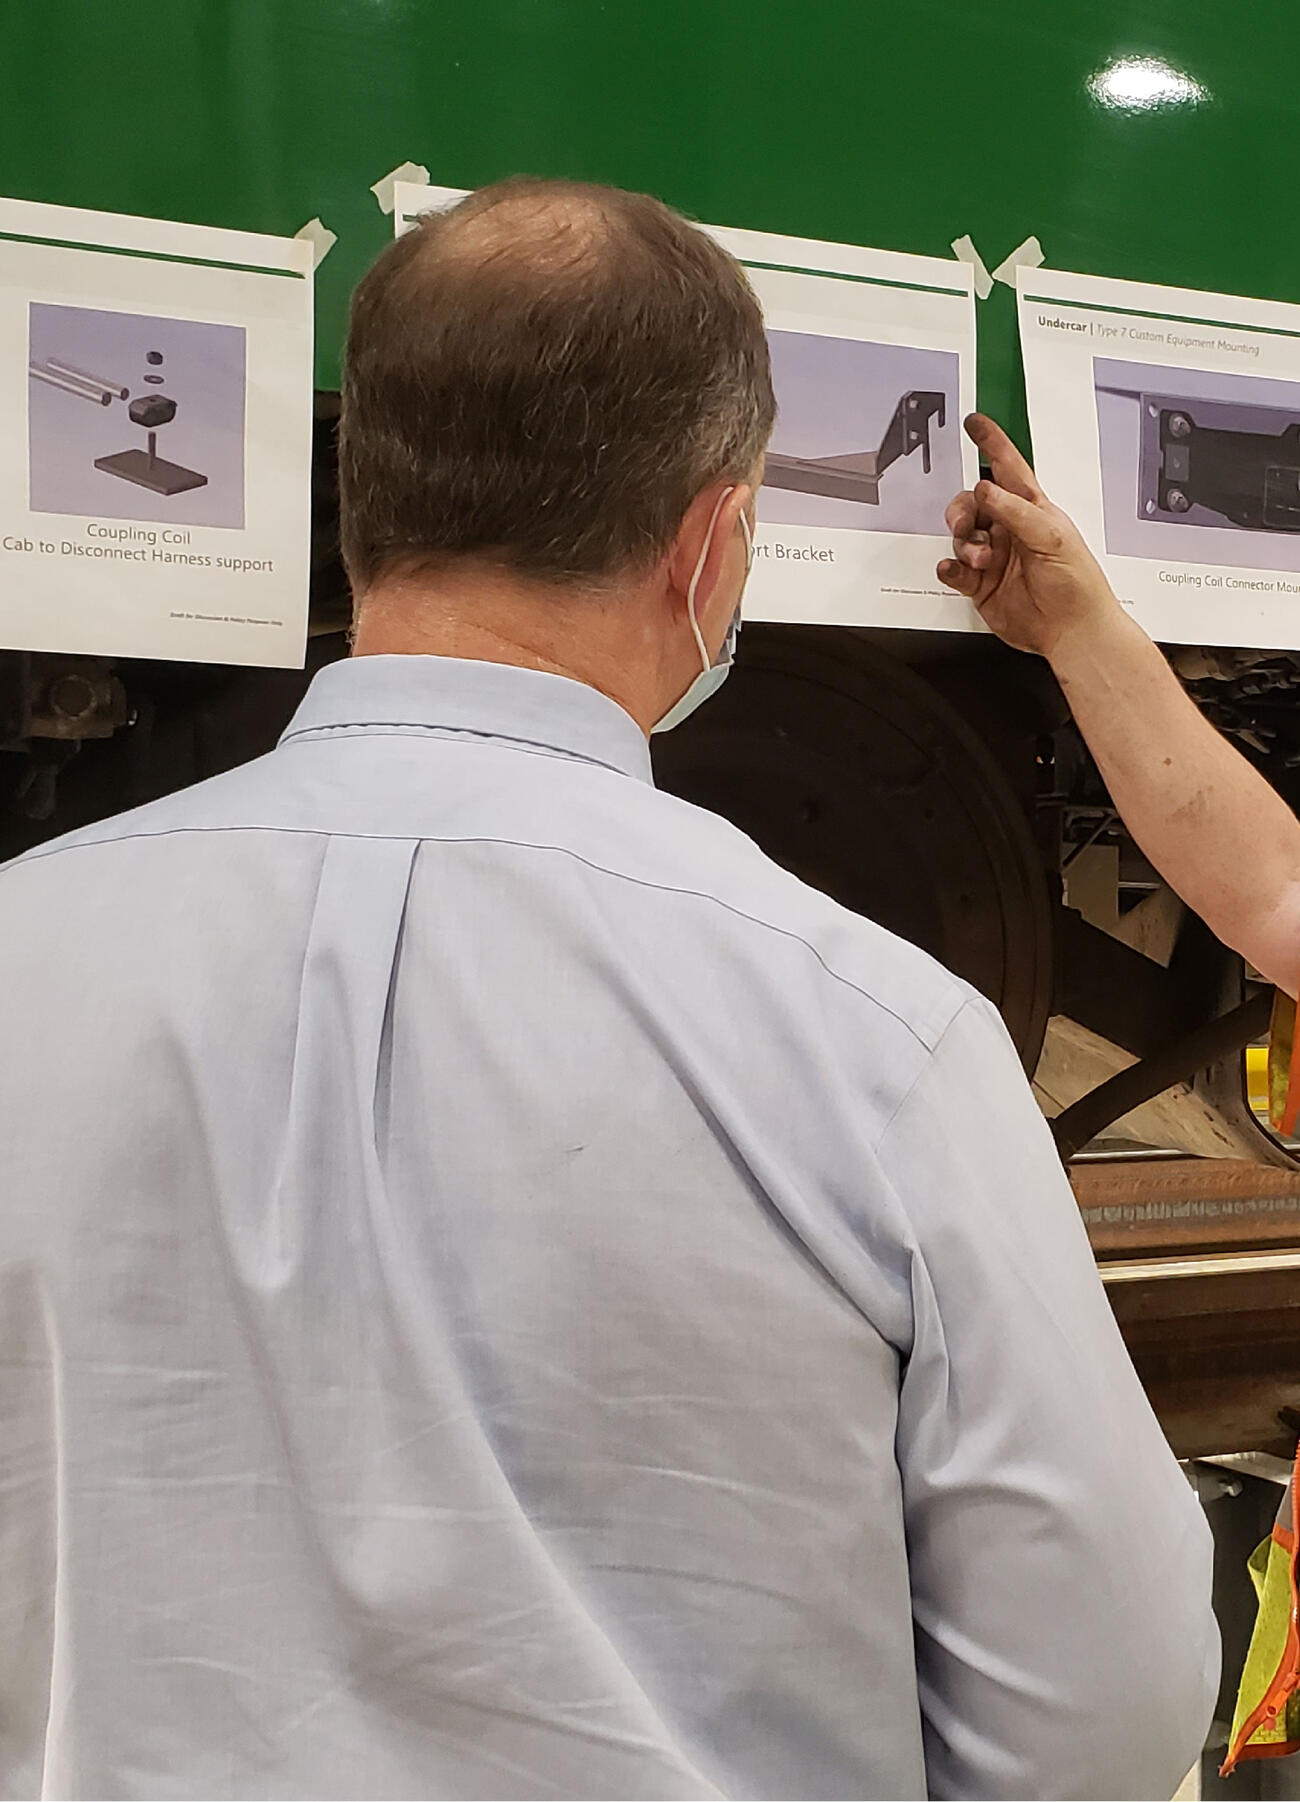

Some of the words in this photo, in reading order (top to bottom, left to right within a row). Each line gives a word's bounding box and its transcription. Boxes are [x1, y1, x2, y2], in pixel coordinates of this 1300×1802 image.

[1037, 315, 1087, 333] Undercar
[1097, 323, 1118, 338] Type
[1121, 327, 1127, 336] 7
[1129, 328, 1165, 343] Custom
[1167, 333, 1216, 350] Equipment
[1217, 340, 1260, 357] Mounting
[87, 523, 157, 545] Coupling
[162, 529, 191, 545] Coil
[2, 536, 34, 552] Cab
[40, 541, 55, 554] to
[61, 541, 147, 562] Disconnect
[151, 549, 212, 567] Harness
[216, 555, 274, 573] support
[775, 543, 835, 562] Bracket
[1158, 570, 1202, 587] Coupling
[1204, 575, 1223, 588] Coil
[1226, 577, 1275, 592] Connector
